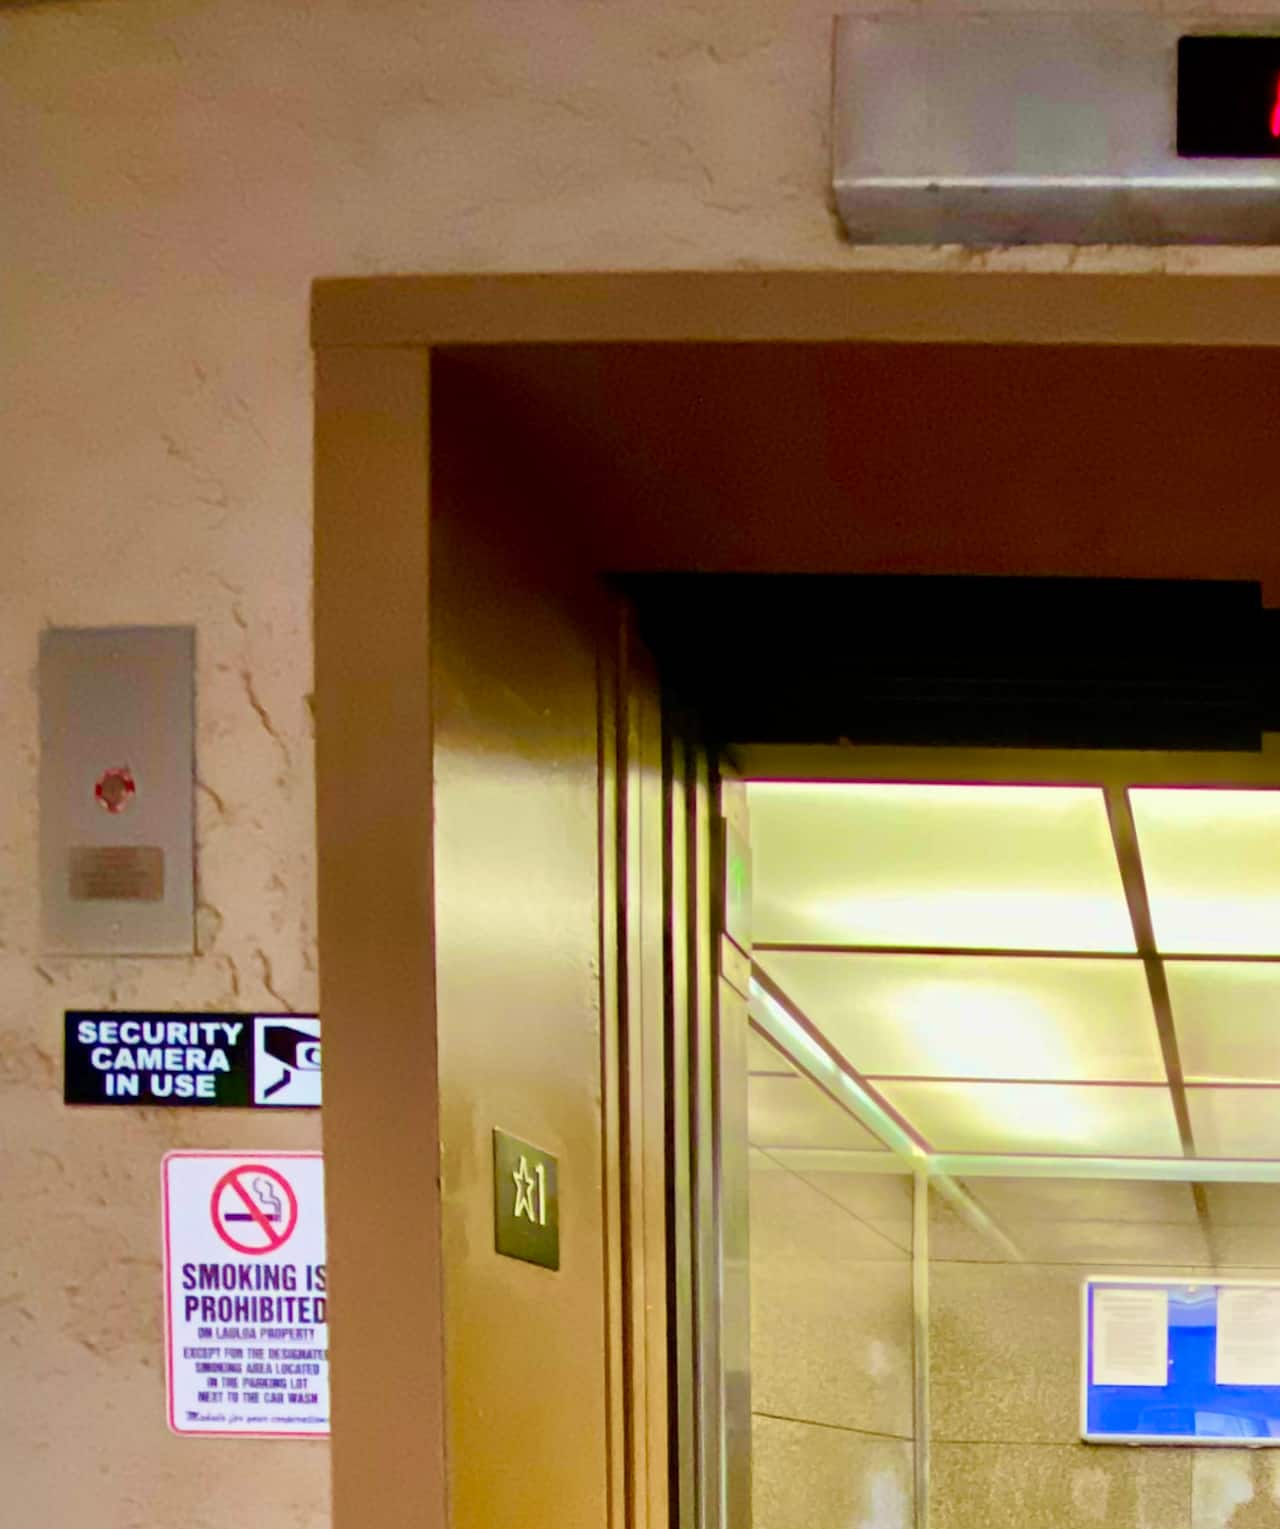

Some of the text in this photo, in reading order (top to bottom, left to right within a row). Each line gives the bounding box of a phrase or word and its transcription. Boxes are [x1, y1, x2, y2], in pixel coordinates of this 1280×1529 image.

[77, 1020, 243, 1045] SECURITY
[91, 1047, 230, 1071] CAMERA
[105, 1073, 216, 1097] IN USE
[182, 1263, 327, 1291] SMOKING IS
[185, 1295, 327, 1323] PROHIBITED
[260, 1328, 315, 1340] PROPERTY
[183, 1347, 221, 1360] EXCEPT
[224, 1347, 243, 1359] FOR
[247, 1348, 264, 1360] THE
[246, 1363, 272, 1375] AREA
[276, 1364, 320, 1376] LOCATED
[242, 1378, 287, 1390] PARKING
[290, 1378, 308, 1390] LOT
[198, 1391, 223, 1403] NEXT
[263, 1392, 284, 1404] CAR
[288, 1393, 318, 1405] WASH
